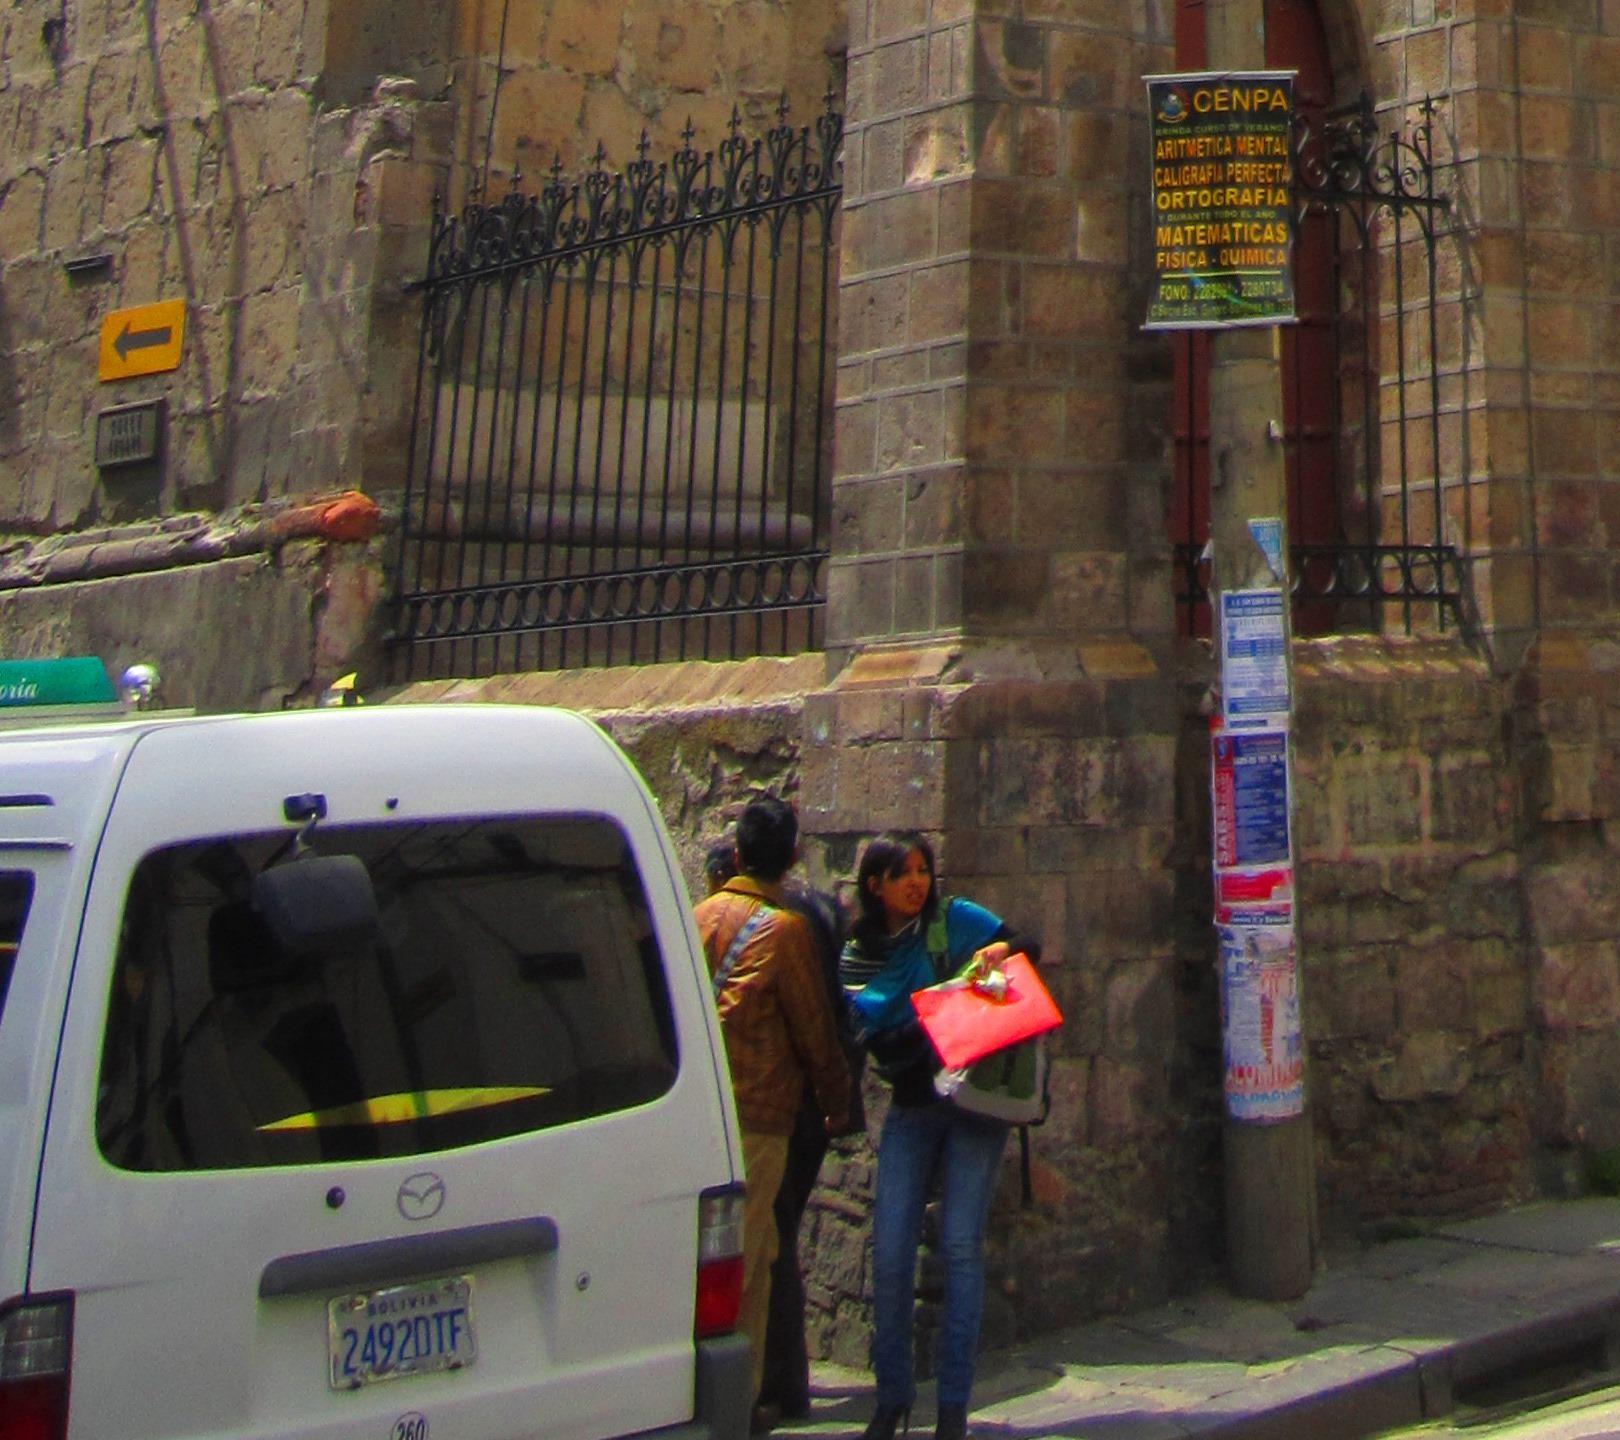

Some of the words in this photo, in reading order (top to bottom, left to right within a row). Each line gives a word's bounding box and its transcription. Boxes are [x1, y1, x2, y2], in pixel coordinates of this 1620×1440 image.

[1193, 87, 1288, 112] CENPA
[1155, 126, 1191, 136] BRINDA
[1244, 123, 1285, 132] VERANO
[1156, 135, 1232, 160] ARITMETICA
[1236, 135, 1288, 156] MENTAL
[1154, 164, 1223, 187] CALIGRAFIA
[1226, 162, 1291, 184] PERFECTA
[1167, 212, 1211, 222] DURANTE
[1156, 250, 1207, 269] FISICA
[367, 1293, 438, 1316] BOLIVIA
[343, 1308, 465, 1376] 2492DTF
